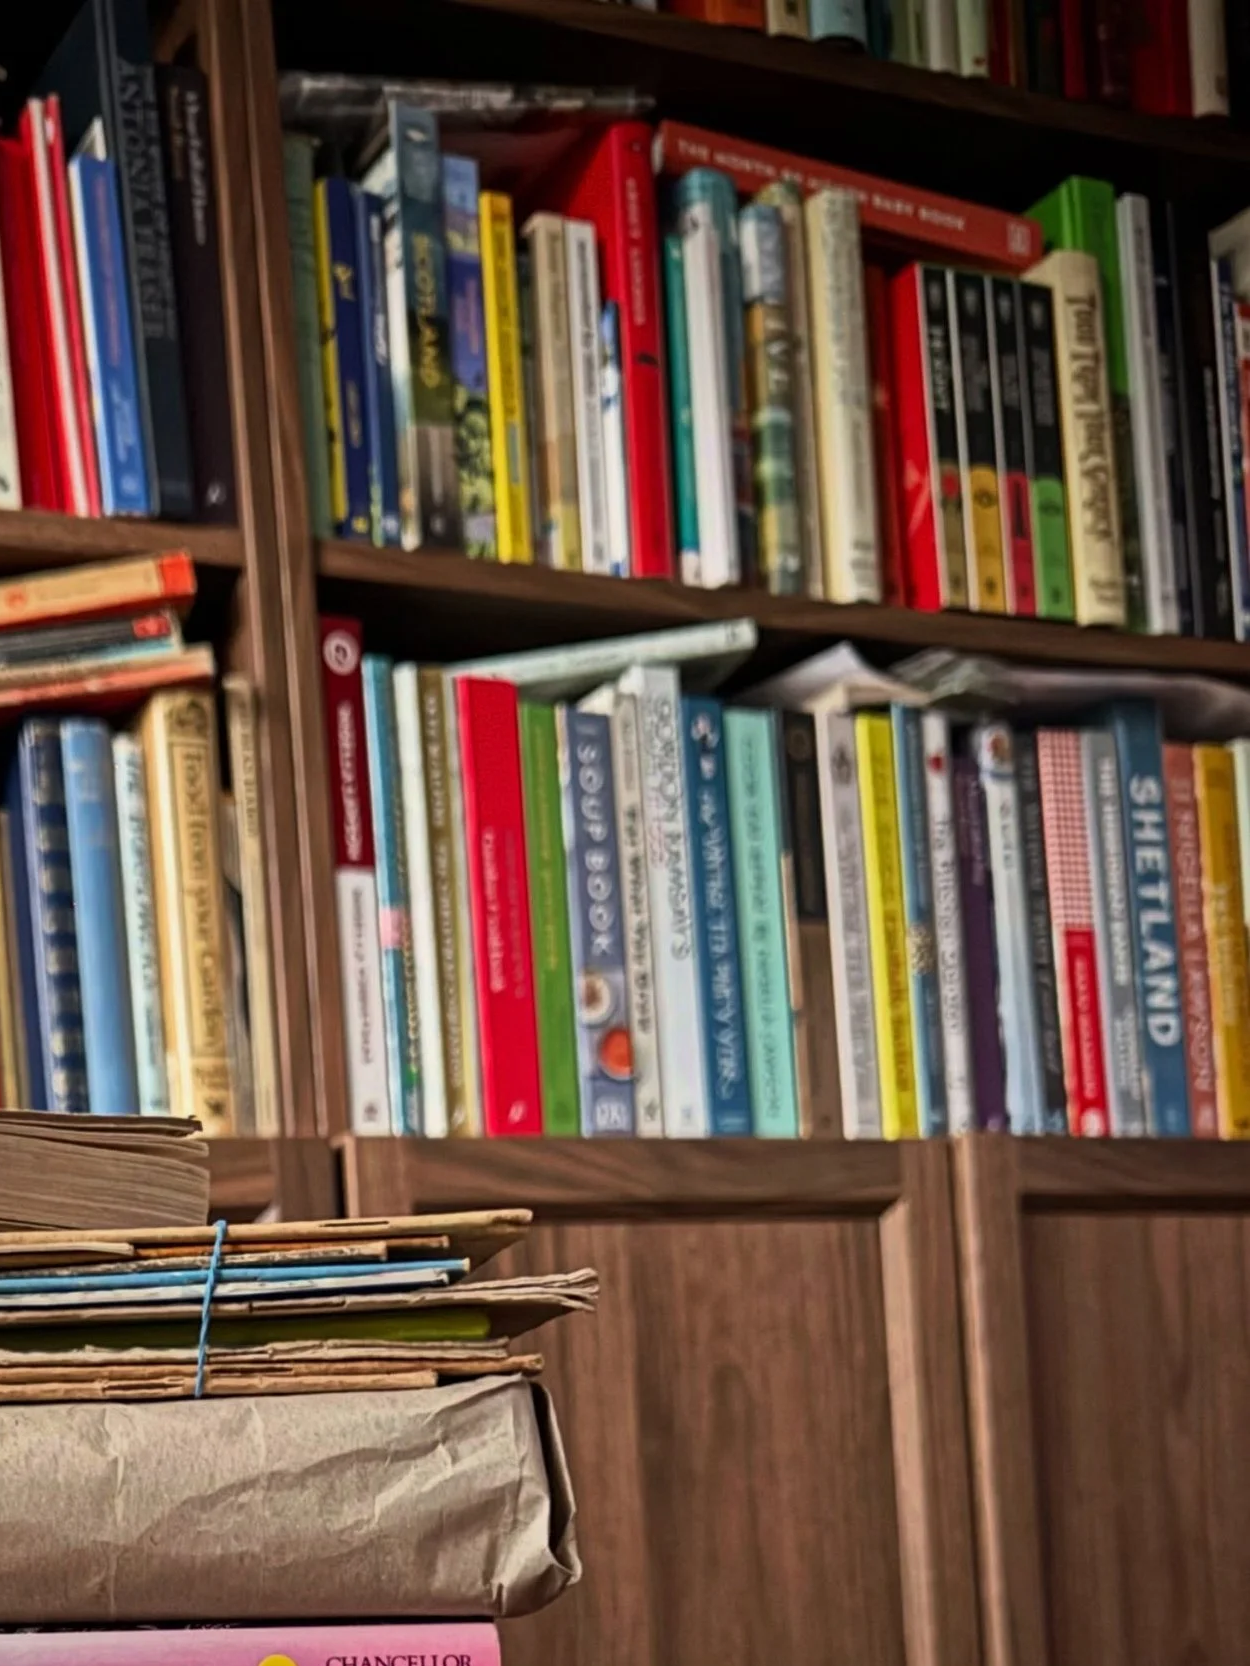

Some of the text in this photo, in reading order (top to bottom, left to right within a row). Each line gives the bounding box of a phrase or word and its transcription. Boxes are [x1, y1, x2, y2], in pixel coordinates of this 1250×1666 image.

[677, 138, 711, 163] THE
[872, 189, 917, 221] BABY
[918, 202, 967, 233] BOOK
[576, 741, 615, 958] SOUP BOOK
[1127, 774, 1182, 1047] SHETLAND
[1174, 809, 1214, 1093] NIGELLA LAWSON
